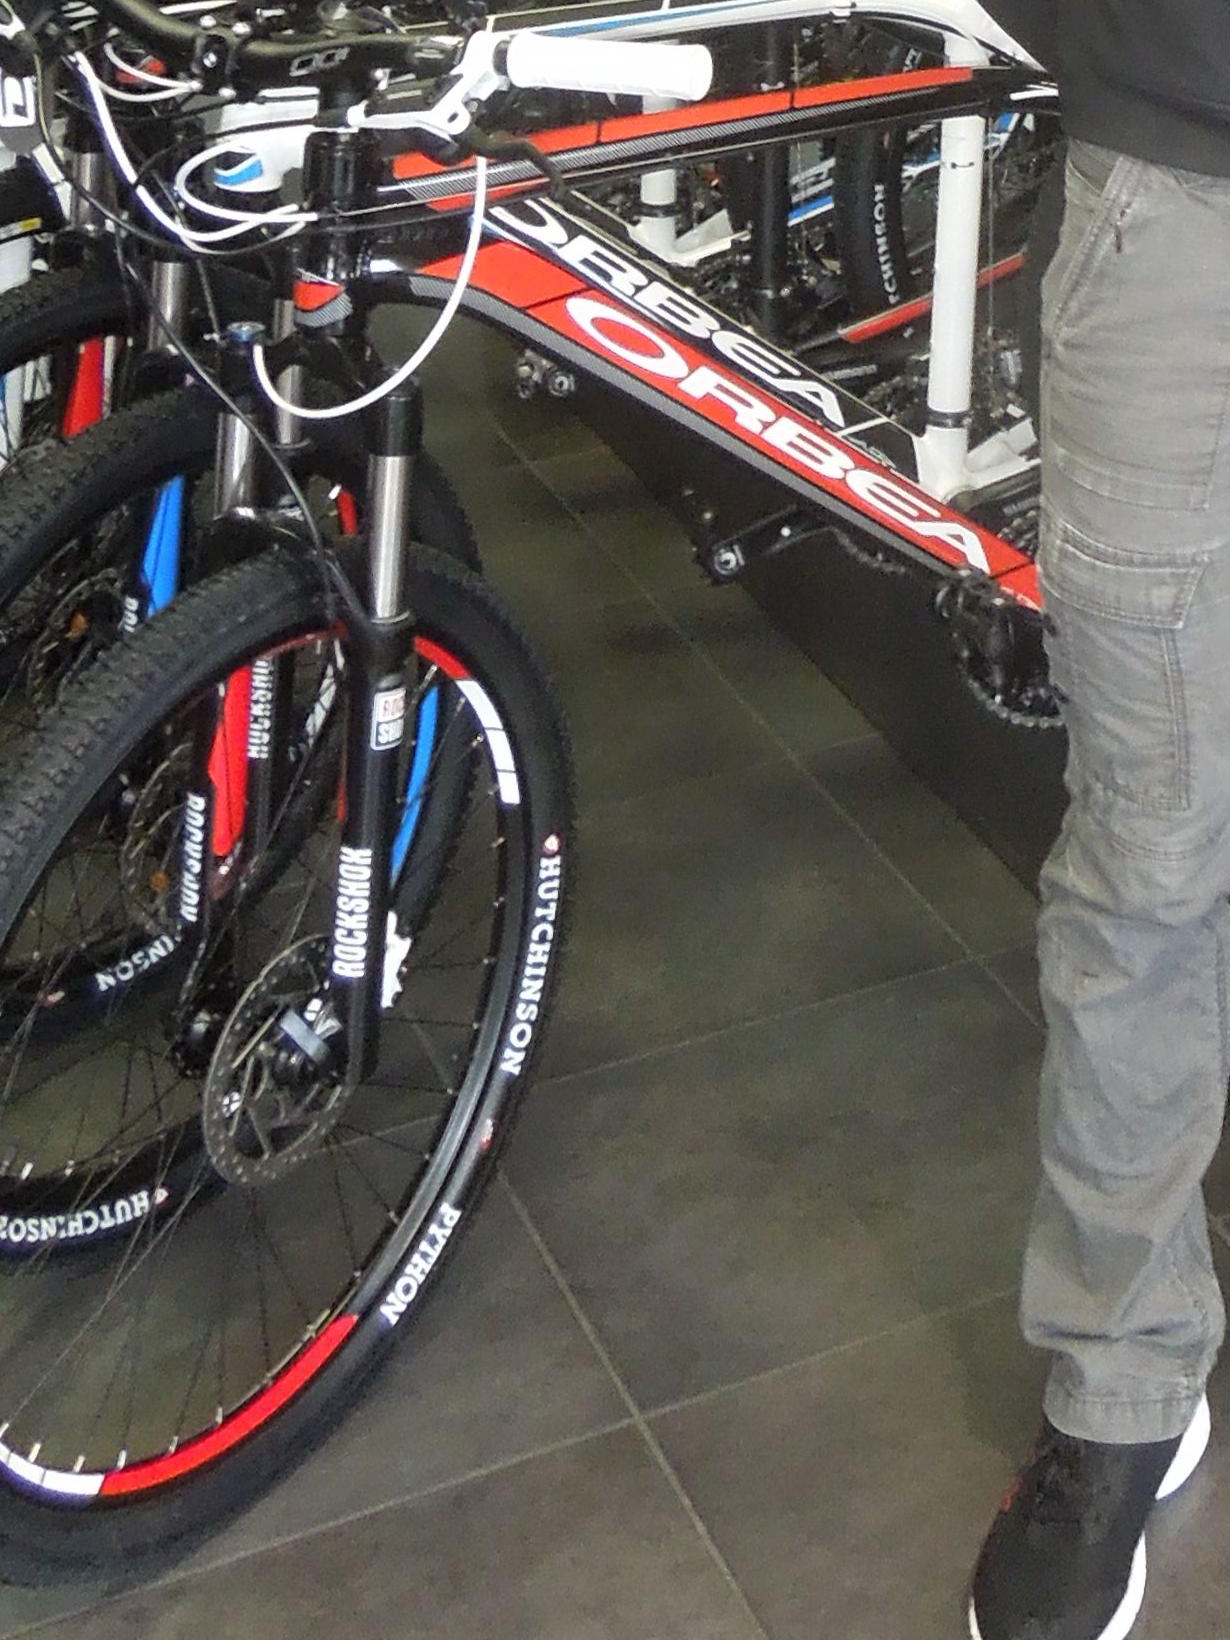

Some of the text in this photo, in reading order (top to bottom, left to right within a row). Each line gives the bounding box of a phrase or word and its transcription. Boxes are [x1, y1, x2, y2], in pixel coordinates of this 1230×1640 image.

[566, 297, 990, 575] ORBEA
[332, 845, 373, 978] ROCKSHOX
[500, 855, 562, 1077] HUTCHINSON
[380, 1203, 460, 1327] PYTHON
